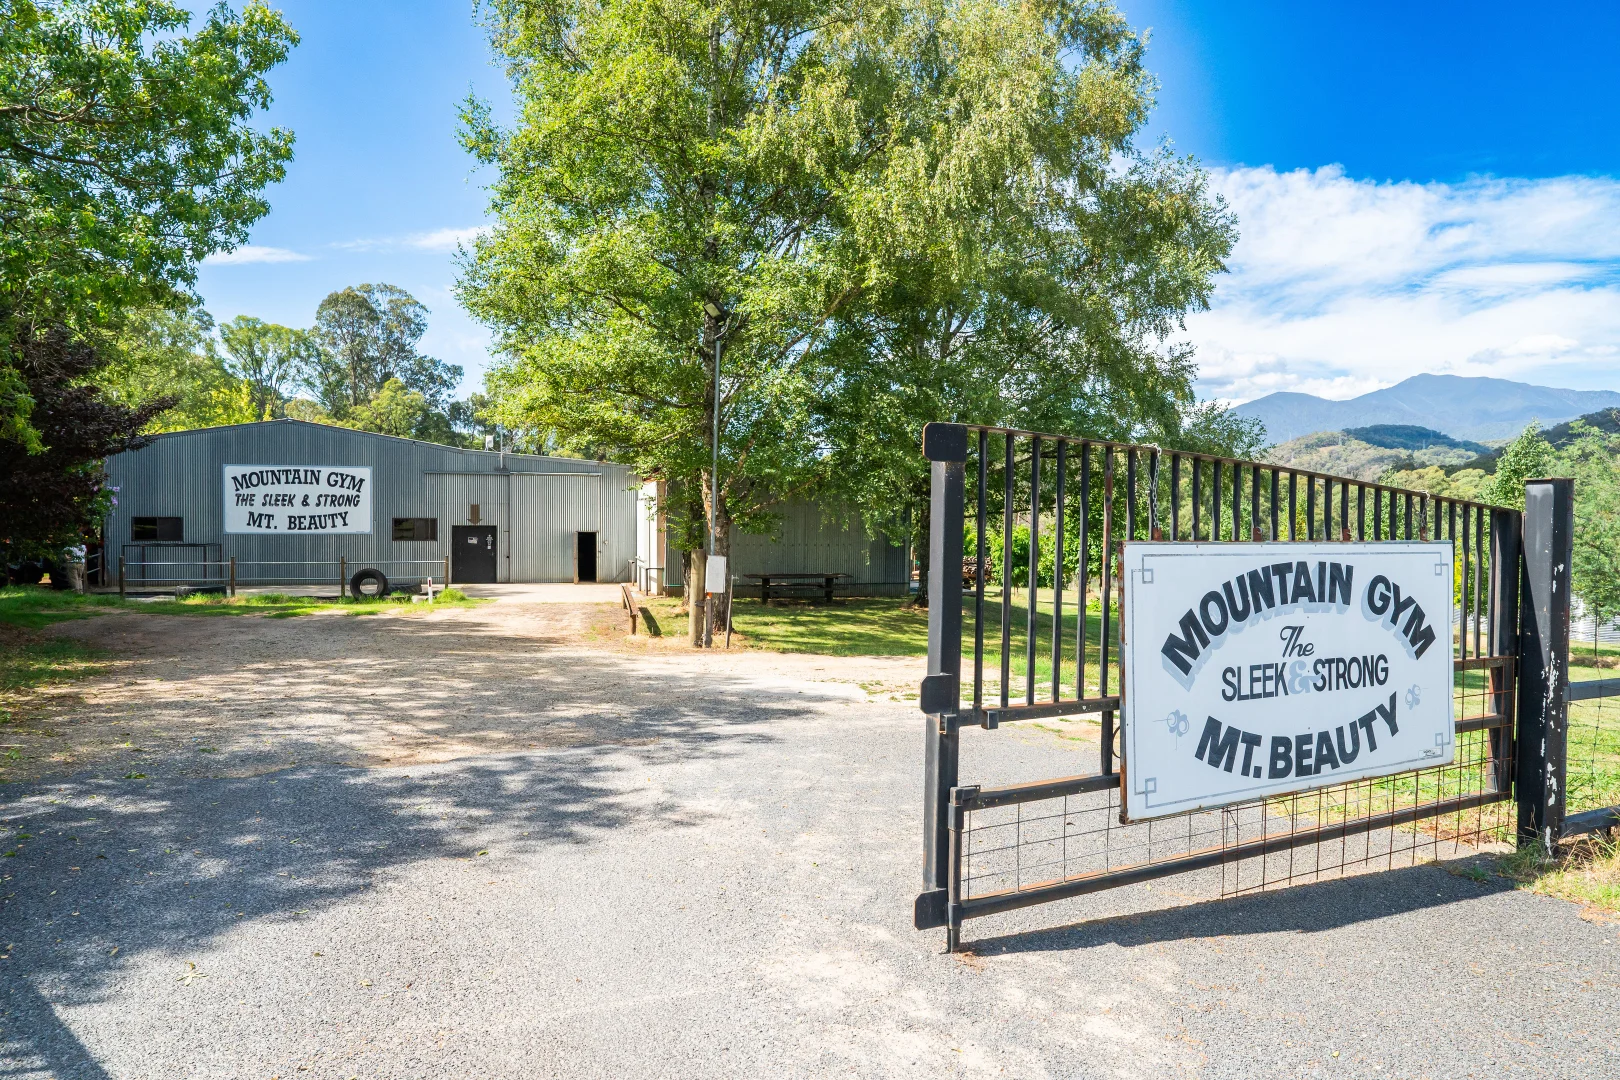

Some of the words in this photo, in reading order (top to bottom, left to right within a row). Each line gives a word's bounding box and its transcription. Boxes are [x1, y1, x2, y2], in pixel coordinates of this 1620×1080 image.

[231, 469, 321, 491] MOUNTAIN
[327, 471, 365, 493] GYM
[235, 493, 256, 507] THE
[262, 493, 296, 507] SLEEK
[301, 494, 310, 507] &
[315, 493, 360, 507] STRONG
[246, 511, 277, 529] MT.
[287, 511, 348, 530] BEAUTY
[1161, 561, 1354, 677] MOUNTAIN
[1367, 574, 1436, 660] GYM
[1280, 625, 1315, 657] The
[1221, 662, 1289, 701] SLEEK
[1288, 660, 1321, 695] &
[1312, 654, 1389, 692] STRONG
[1194, 715, 1263, 779] MT.
[1267, 691, 1399, 780] BEAUTY
